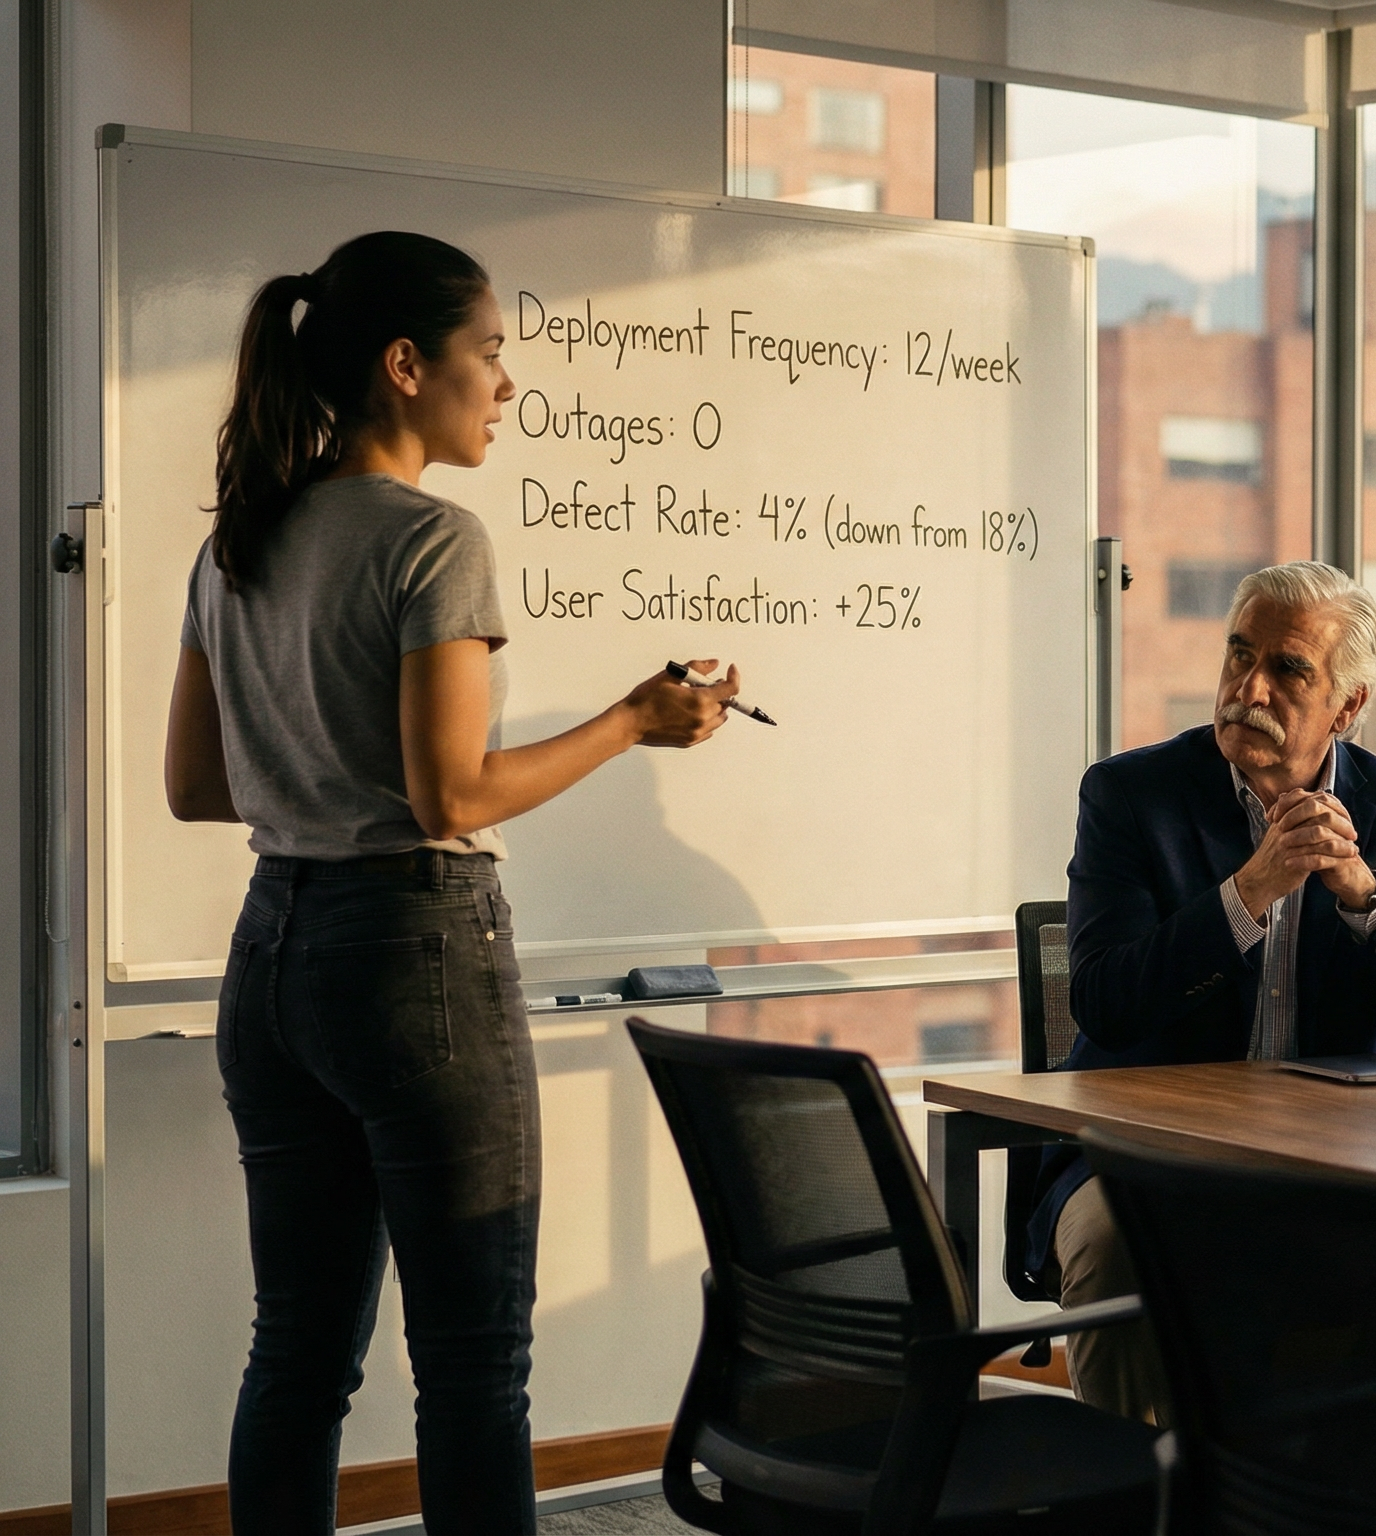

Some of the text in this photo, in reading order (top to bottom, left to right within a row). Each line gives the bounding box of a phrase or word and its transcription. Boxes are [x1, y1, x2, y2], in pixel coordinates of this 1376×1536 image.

[518, 290, 1022, 392] Deployment Frequency: 12/week
[518, 389, 722, 466] Outages: 0
[522, 477, 1039, 562] Defect Rate: 4% (down from 18%)
[522, 567, 922, 631] User Satisfaction: +25%
